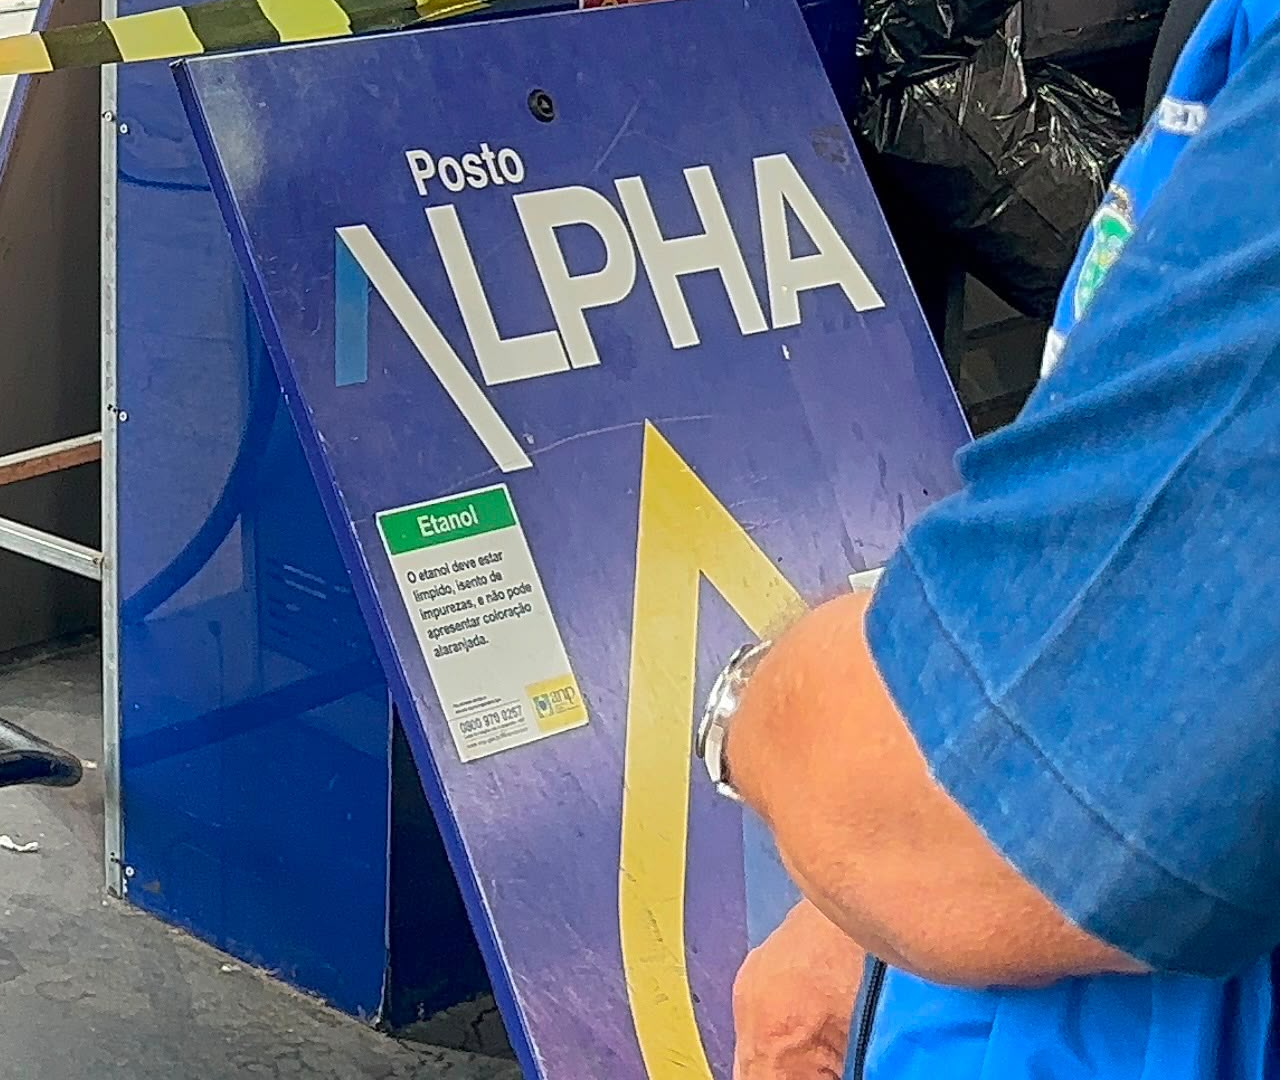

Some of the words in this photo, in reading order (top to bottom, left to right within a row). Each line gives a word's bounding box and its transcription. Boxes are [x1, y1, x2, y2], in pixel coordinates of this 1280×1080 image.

[405, 142, 525, 197] Posto
[416, 504, 479, 538] Etanol
[407, 571, 417, 584] O
[419, 562, 451, 581] etanol
[451, 559, 477, 574] deve
[478, 551, 503, 567] estar
[455, 575, 488, 592] isento
[419, 598, 477, 621] impurezas,
[485, 590, 506, 604] não
[506, 582, 532, 601] pode
[427, 616, 480, 640] apresentar
[482, 602, 532, 625] coloração
[433, 634, 489, 658] alaranjada.
[550, 685, 576, 706] anp
